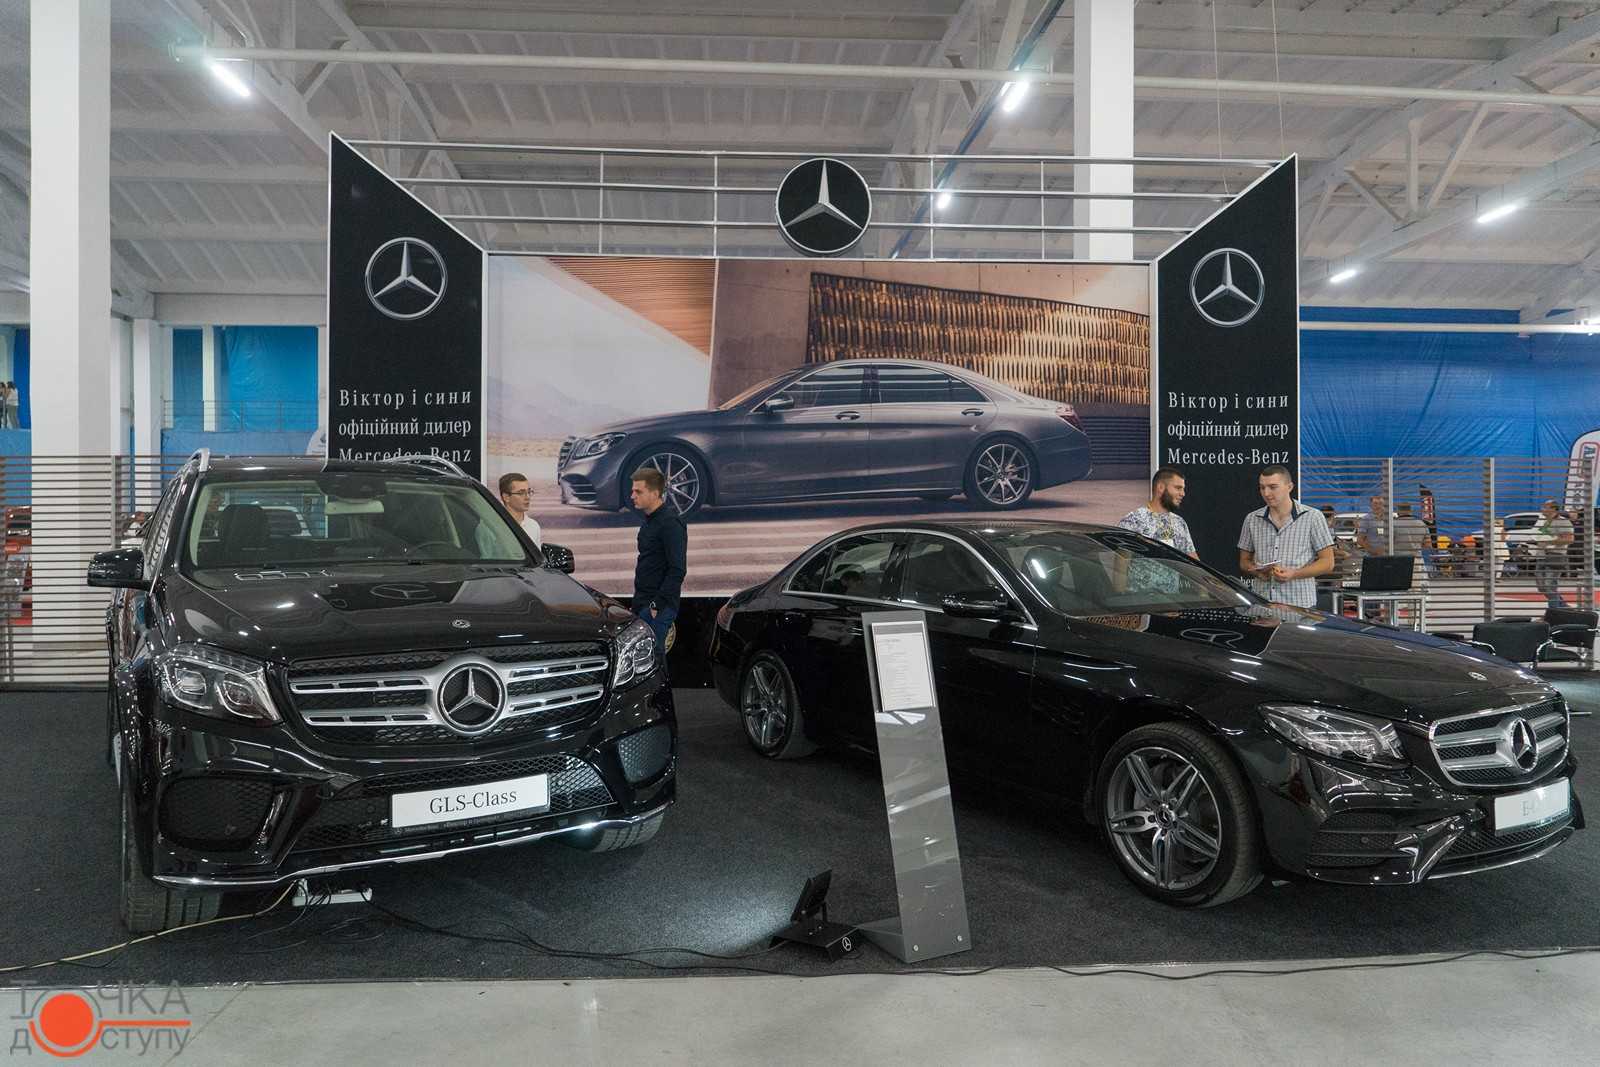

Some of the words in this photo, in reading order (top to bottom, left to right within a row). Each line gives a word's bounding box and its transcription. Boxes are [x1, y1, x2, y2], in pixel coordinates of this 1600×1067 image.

[339, 389, 404, 410] Віктор
[424, 390, 472, 406] сини
[1168, 391, 1228, 413] Віктор
[1246, 395, 1289, 409] сини
[338, 417, 419, 439] офіційний
[423, 419, 472, 437] дилер
[1167, 420, 1241, 440] офіційний
[1244, 423, 1289, 439] дилер
[339, 447, 471, 464] MercedsBenz
[1168, 447, 1289, 465] Mercedes-Benz
[429, 790, 517, 815] GLS-Class
